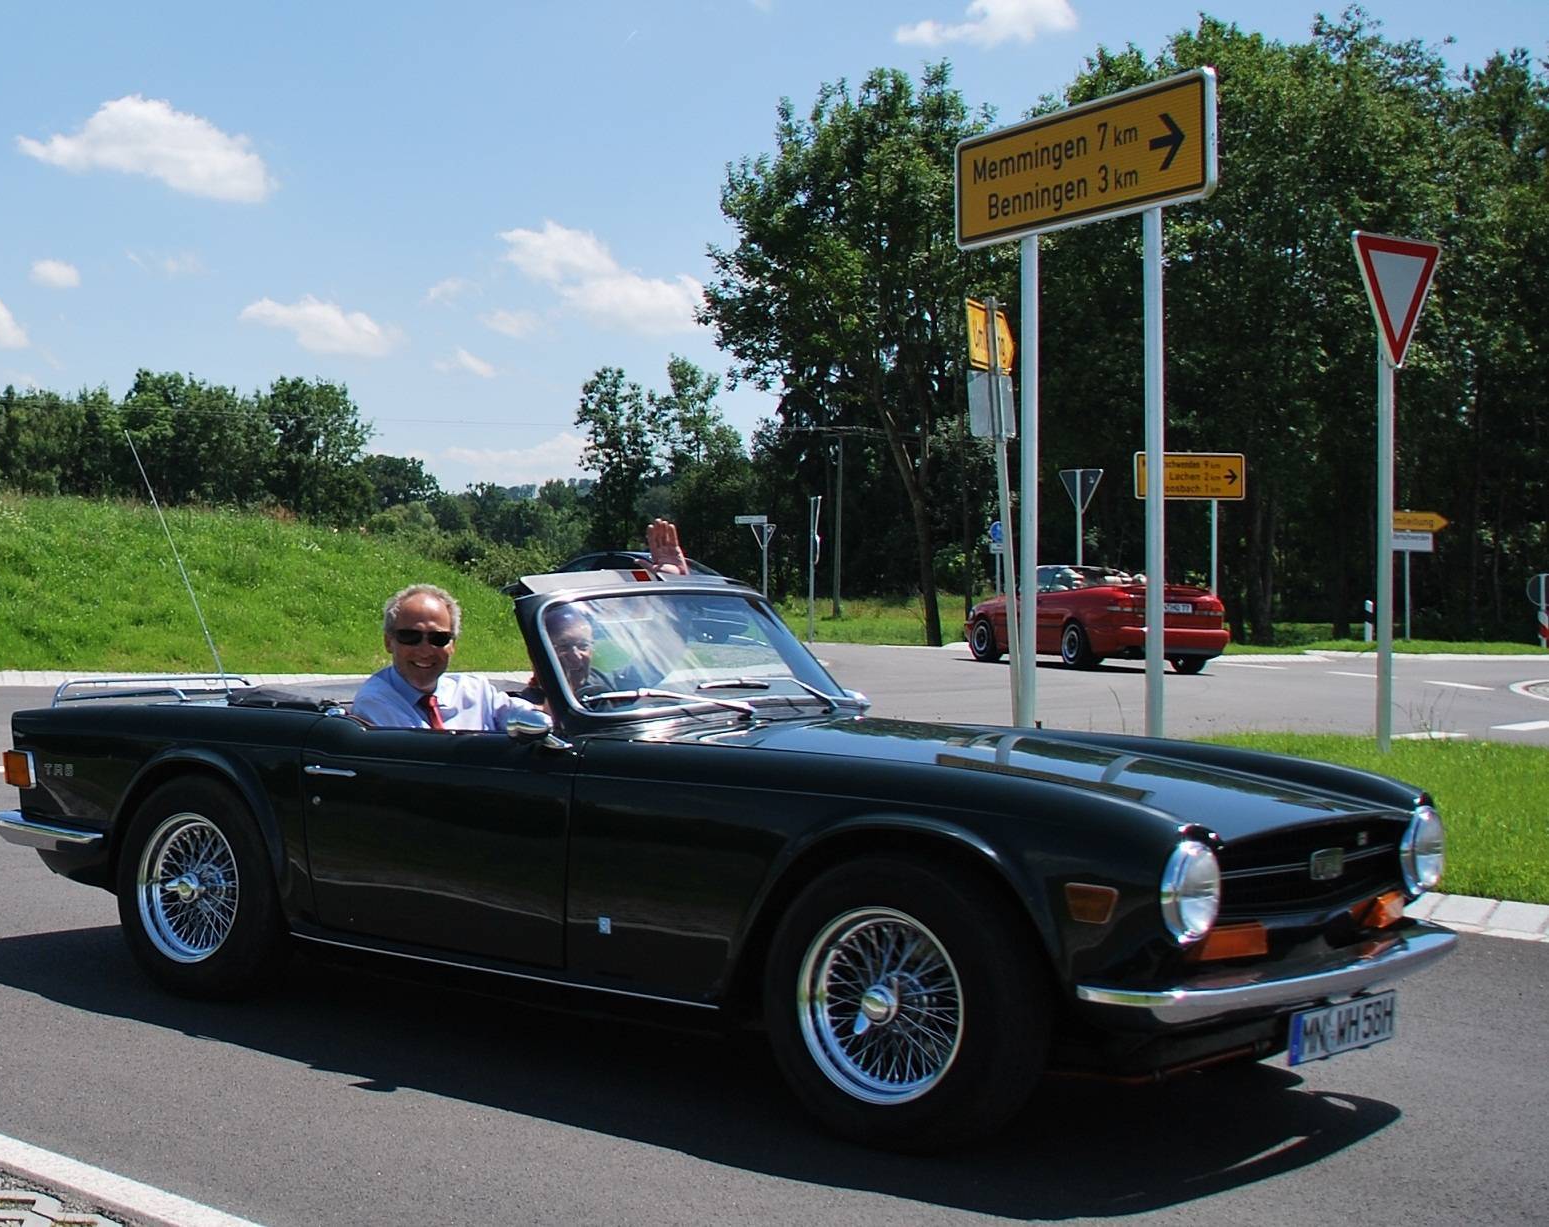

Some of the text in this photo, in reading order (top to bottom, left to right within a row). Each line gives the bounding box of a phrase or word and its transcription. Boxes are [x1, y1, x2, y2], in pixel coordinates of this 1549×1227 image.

[972, 122, 1139, 185] Memmingen 7 km
[987, 165, 1139, 220] Benningen 3 km
